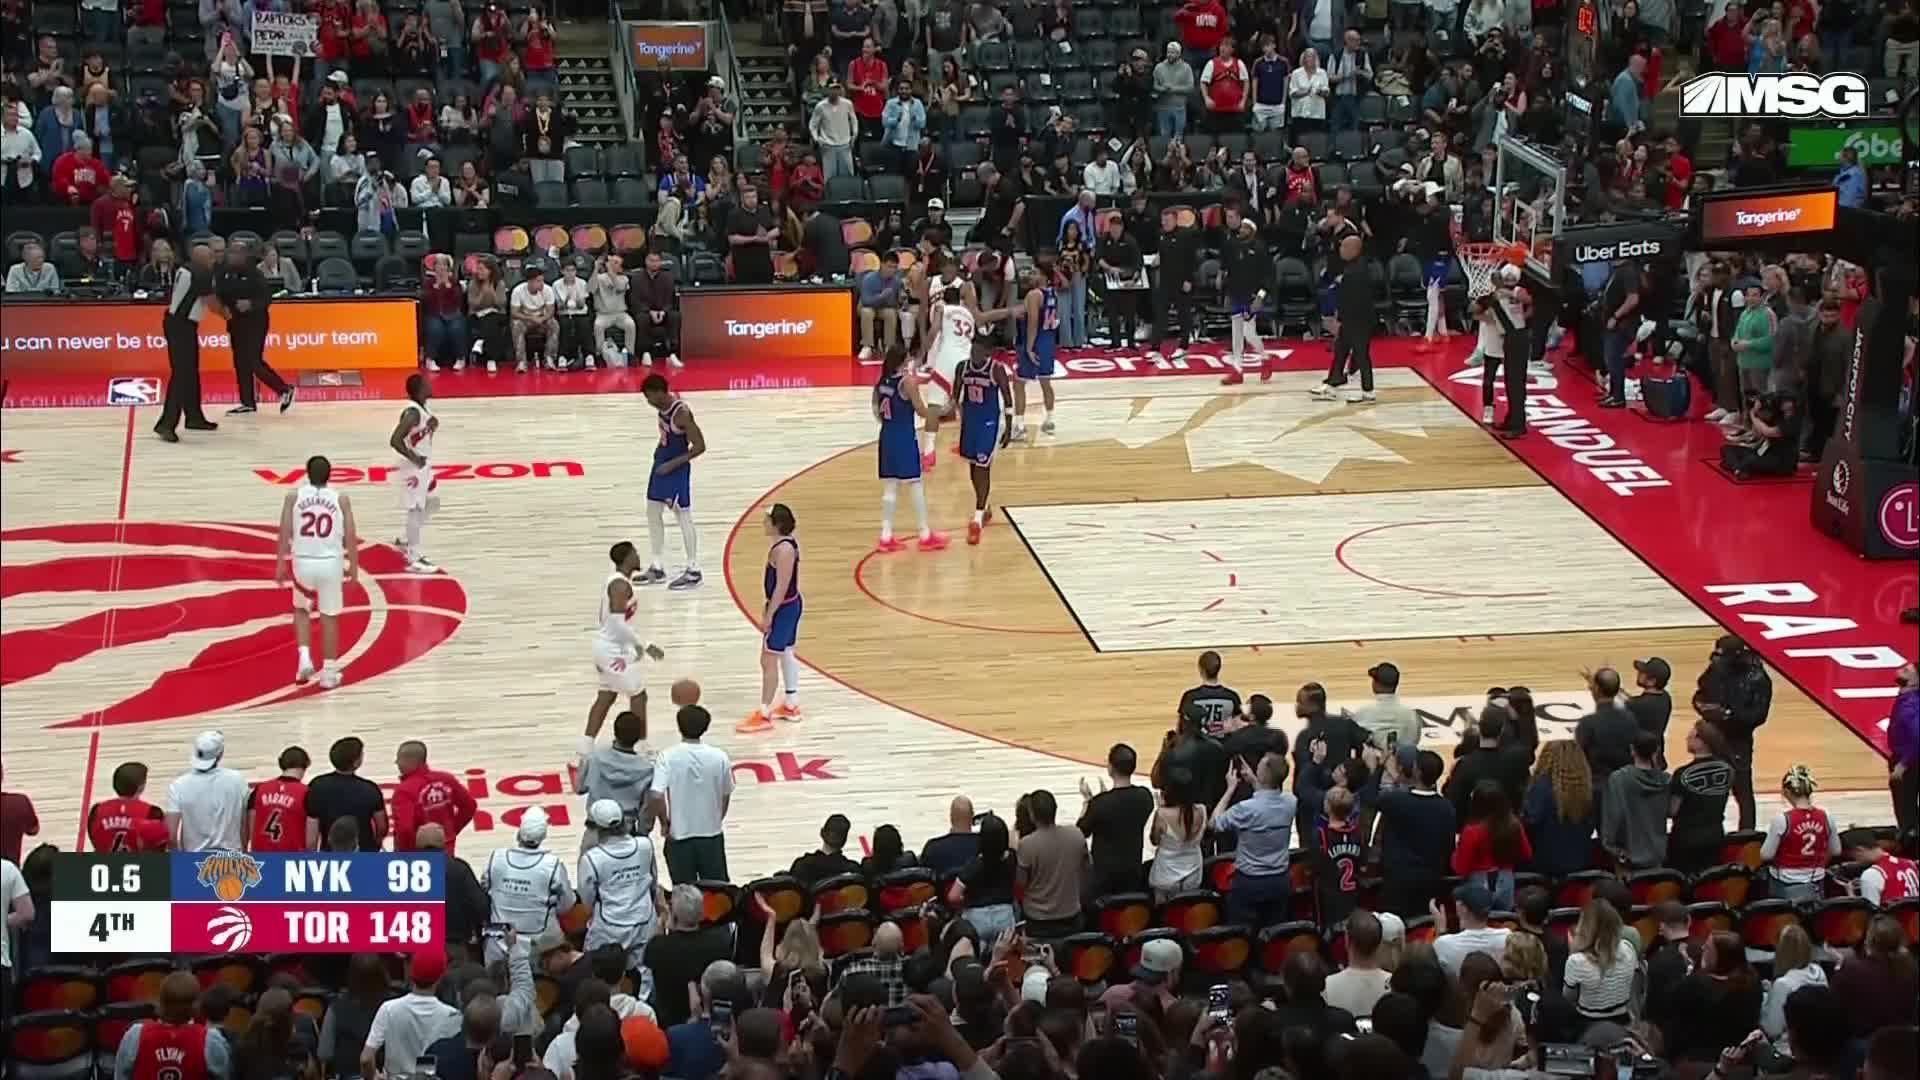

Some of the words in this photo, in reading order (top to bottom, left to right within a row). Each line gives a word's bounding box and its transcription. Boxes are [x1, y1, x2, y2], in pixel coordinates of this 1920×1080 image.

[1736, 208, 1797, 227] Tangerine
[1575, 245, 1617, 262] Uber
[1618, 239, 1661, 257] Eats
[15, 337, 51, 350] can
[58, 337, 111, 350] never
[117, 333, 141, 349] be
[286, 333, 328, 350] your
[332, 330, 378, 345] team
[724, 319, 807, 339] Tangerine
[1844, 402, 1855, 441] CITY
[300, 511, 333, 538] 20
[265, 808, 283, 842] 4
[1800, 832, 1817, 856] 2
[1336, 857, 1357, 892] 2
